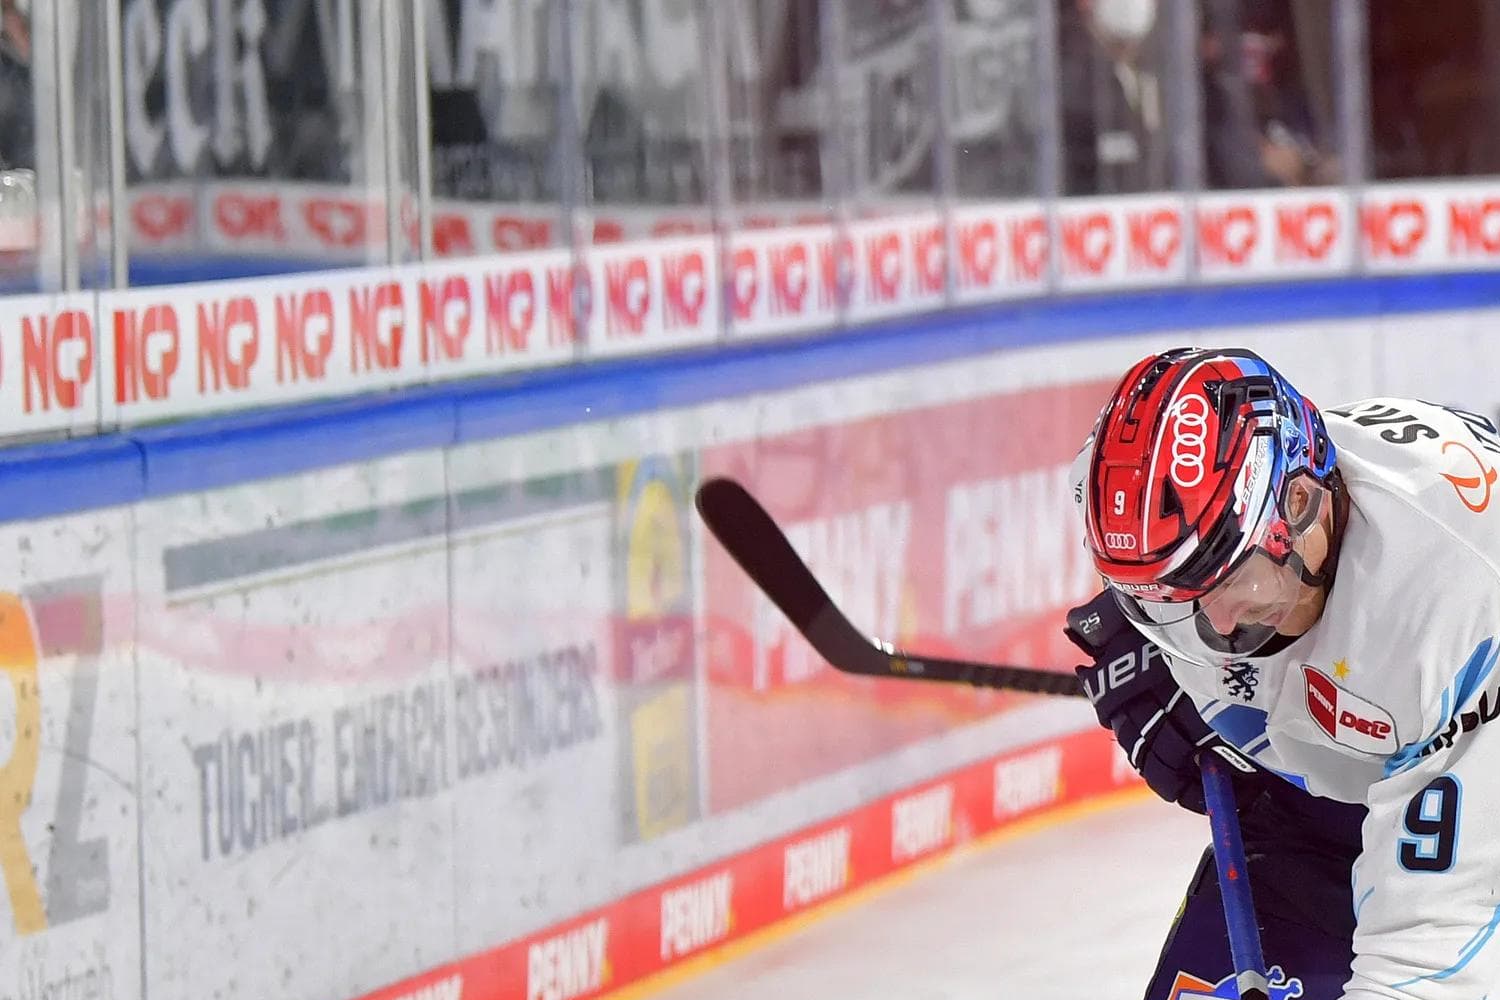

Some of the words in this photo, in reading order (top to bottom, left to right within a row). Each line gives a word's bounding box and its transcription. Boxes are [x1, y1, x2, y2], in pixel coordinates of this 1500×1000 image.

[1114, 491, 1125, 515] 9
[1339, 709, 1392, 740] DEL
[1397, 772, 1464, 875] 9
